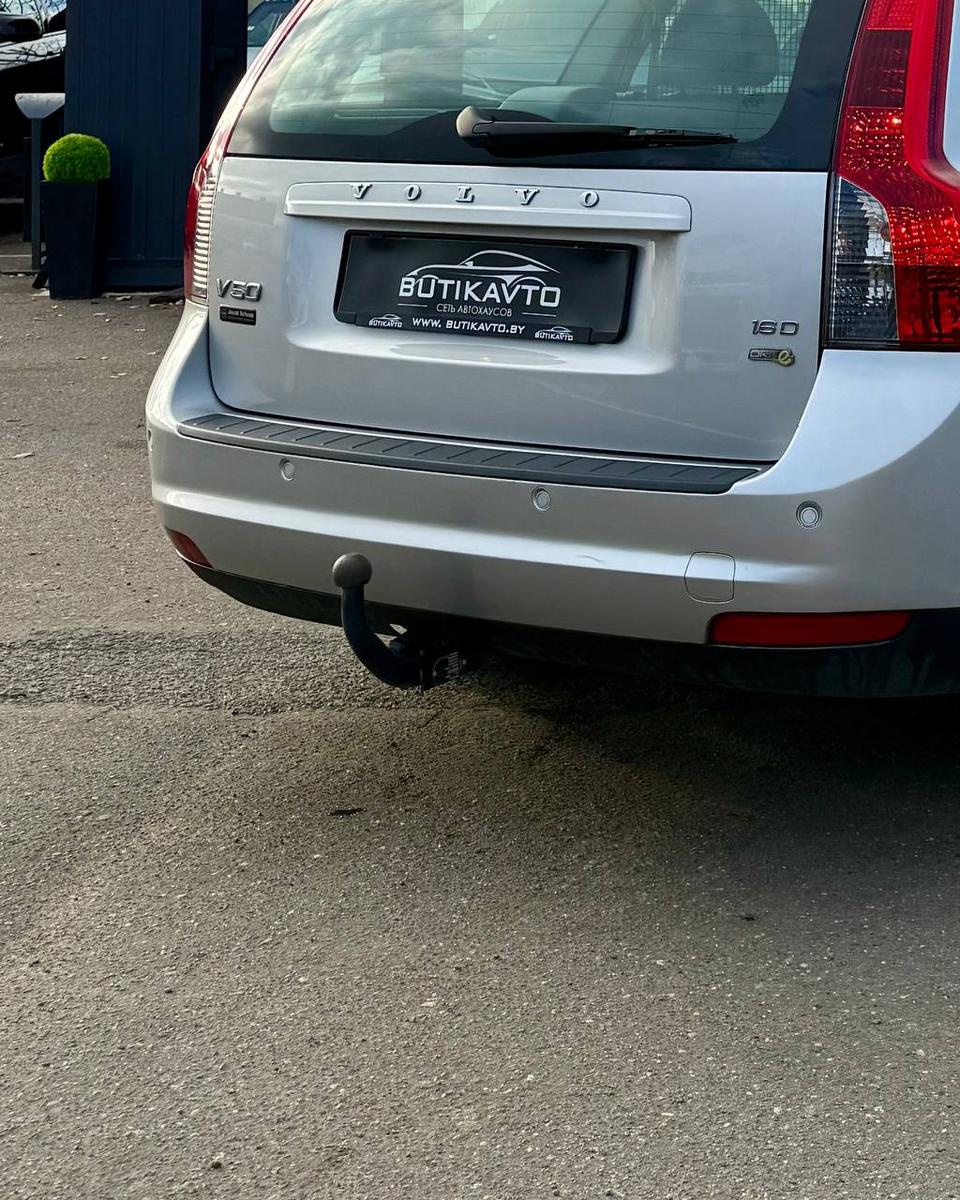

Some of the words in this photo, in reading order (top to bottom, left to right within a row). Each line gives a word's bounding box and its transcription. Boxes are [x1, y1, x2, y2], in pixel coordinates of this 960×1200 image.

[350, 183, 600, 208] VOLVO
[216, 278, 263, 302] V50
[398, 276, 561, 308] BUTIKAVTO
[436, 303, 456, 313] СЕТЬ
[457, 304, 513, 318] АВТОХАУСОВ
[368, 319, 403, 329] BUTIKAVTO
[412, 317, 442, 328] WWW.
[445, 319, 526, 335] BUTIKAVTO.BY
[534, 331, 574, 341] BUTIKAVTO
